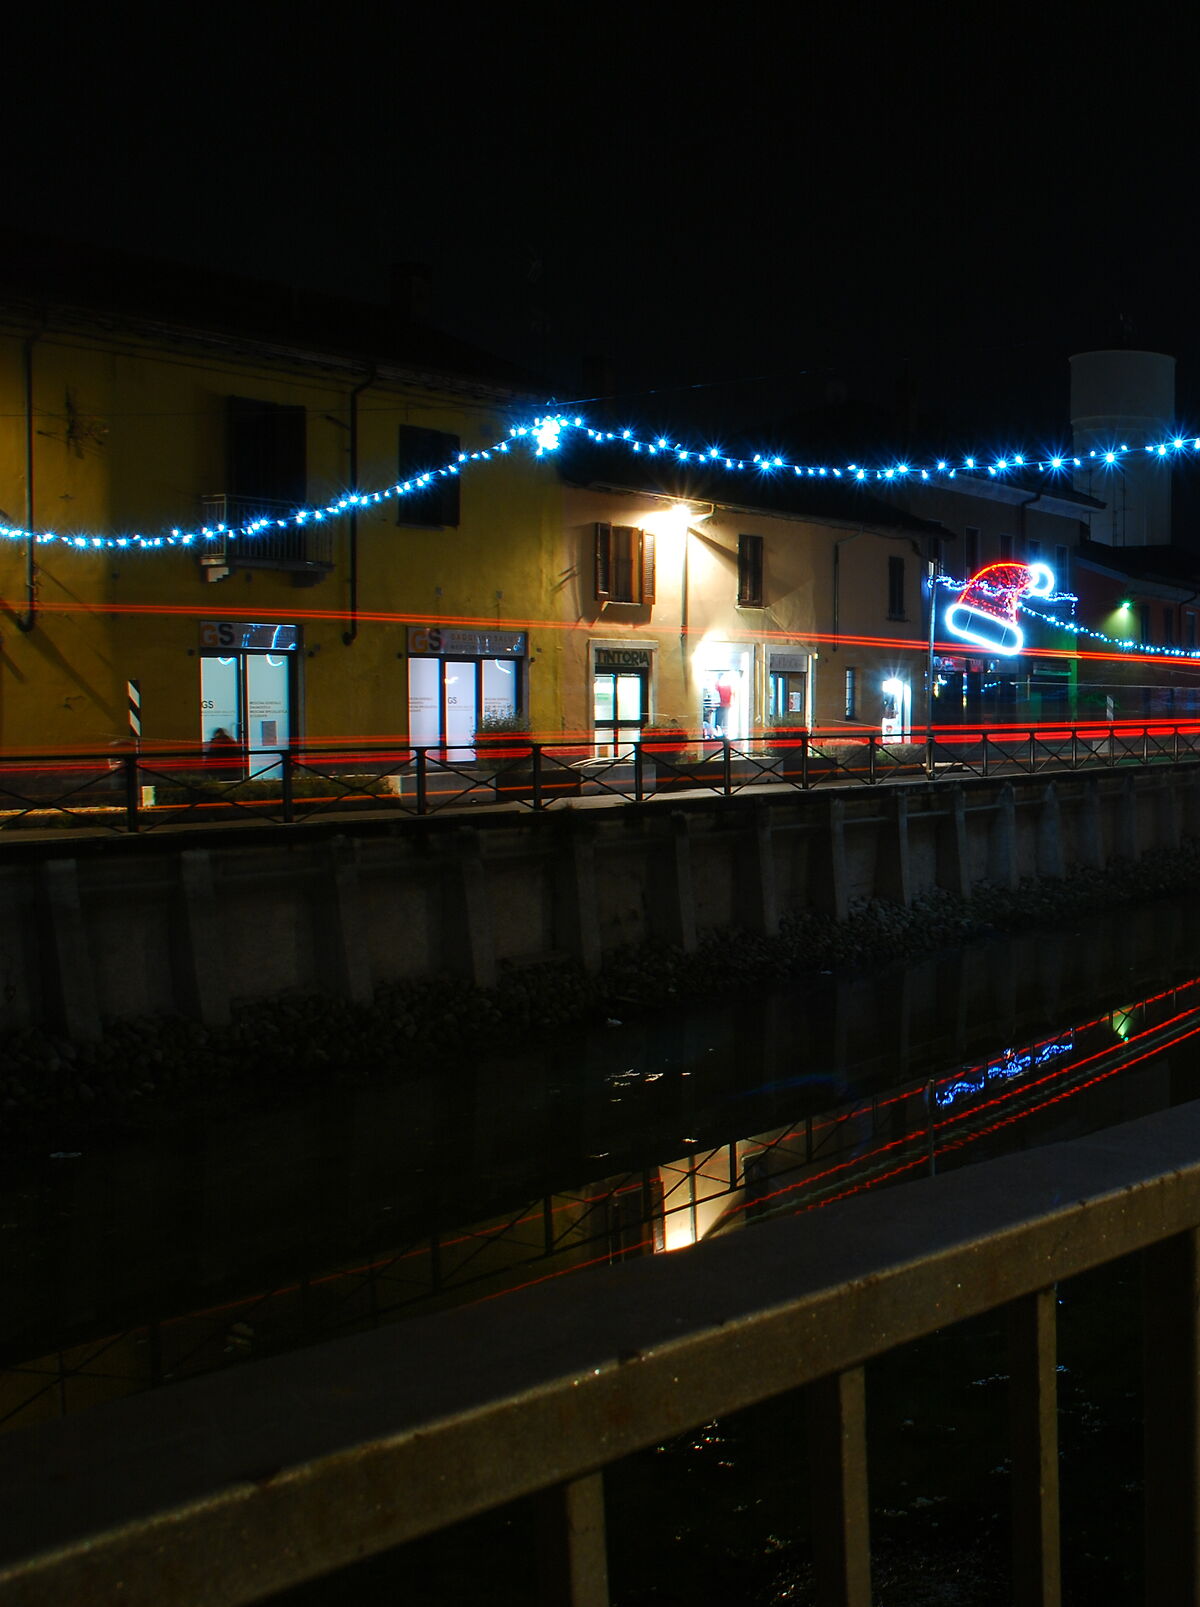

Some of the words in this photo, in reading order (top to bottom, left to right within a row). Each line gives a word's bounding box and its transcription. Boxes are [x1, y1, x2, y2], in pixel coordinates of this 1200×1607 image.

[202, 623, 235, 647] GS
[411, 628, 444, 653] GS
[595, 649, 650, 666] TINTORIA
[202, 700, 214, 709] GS
